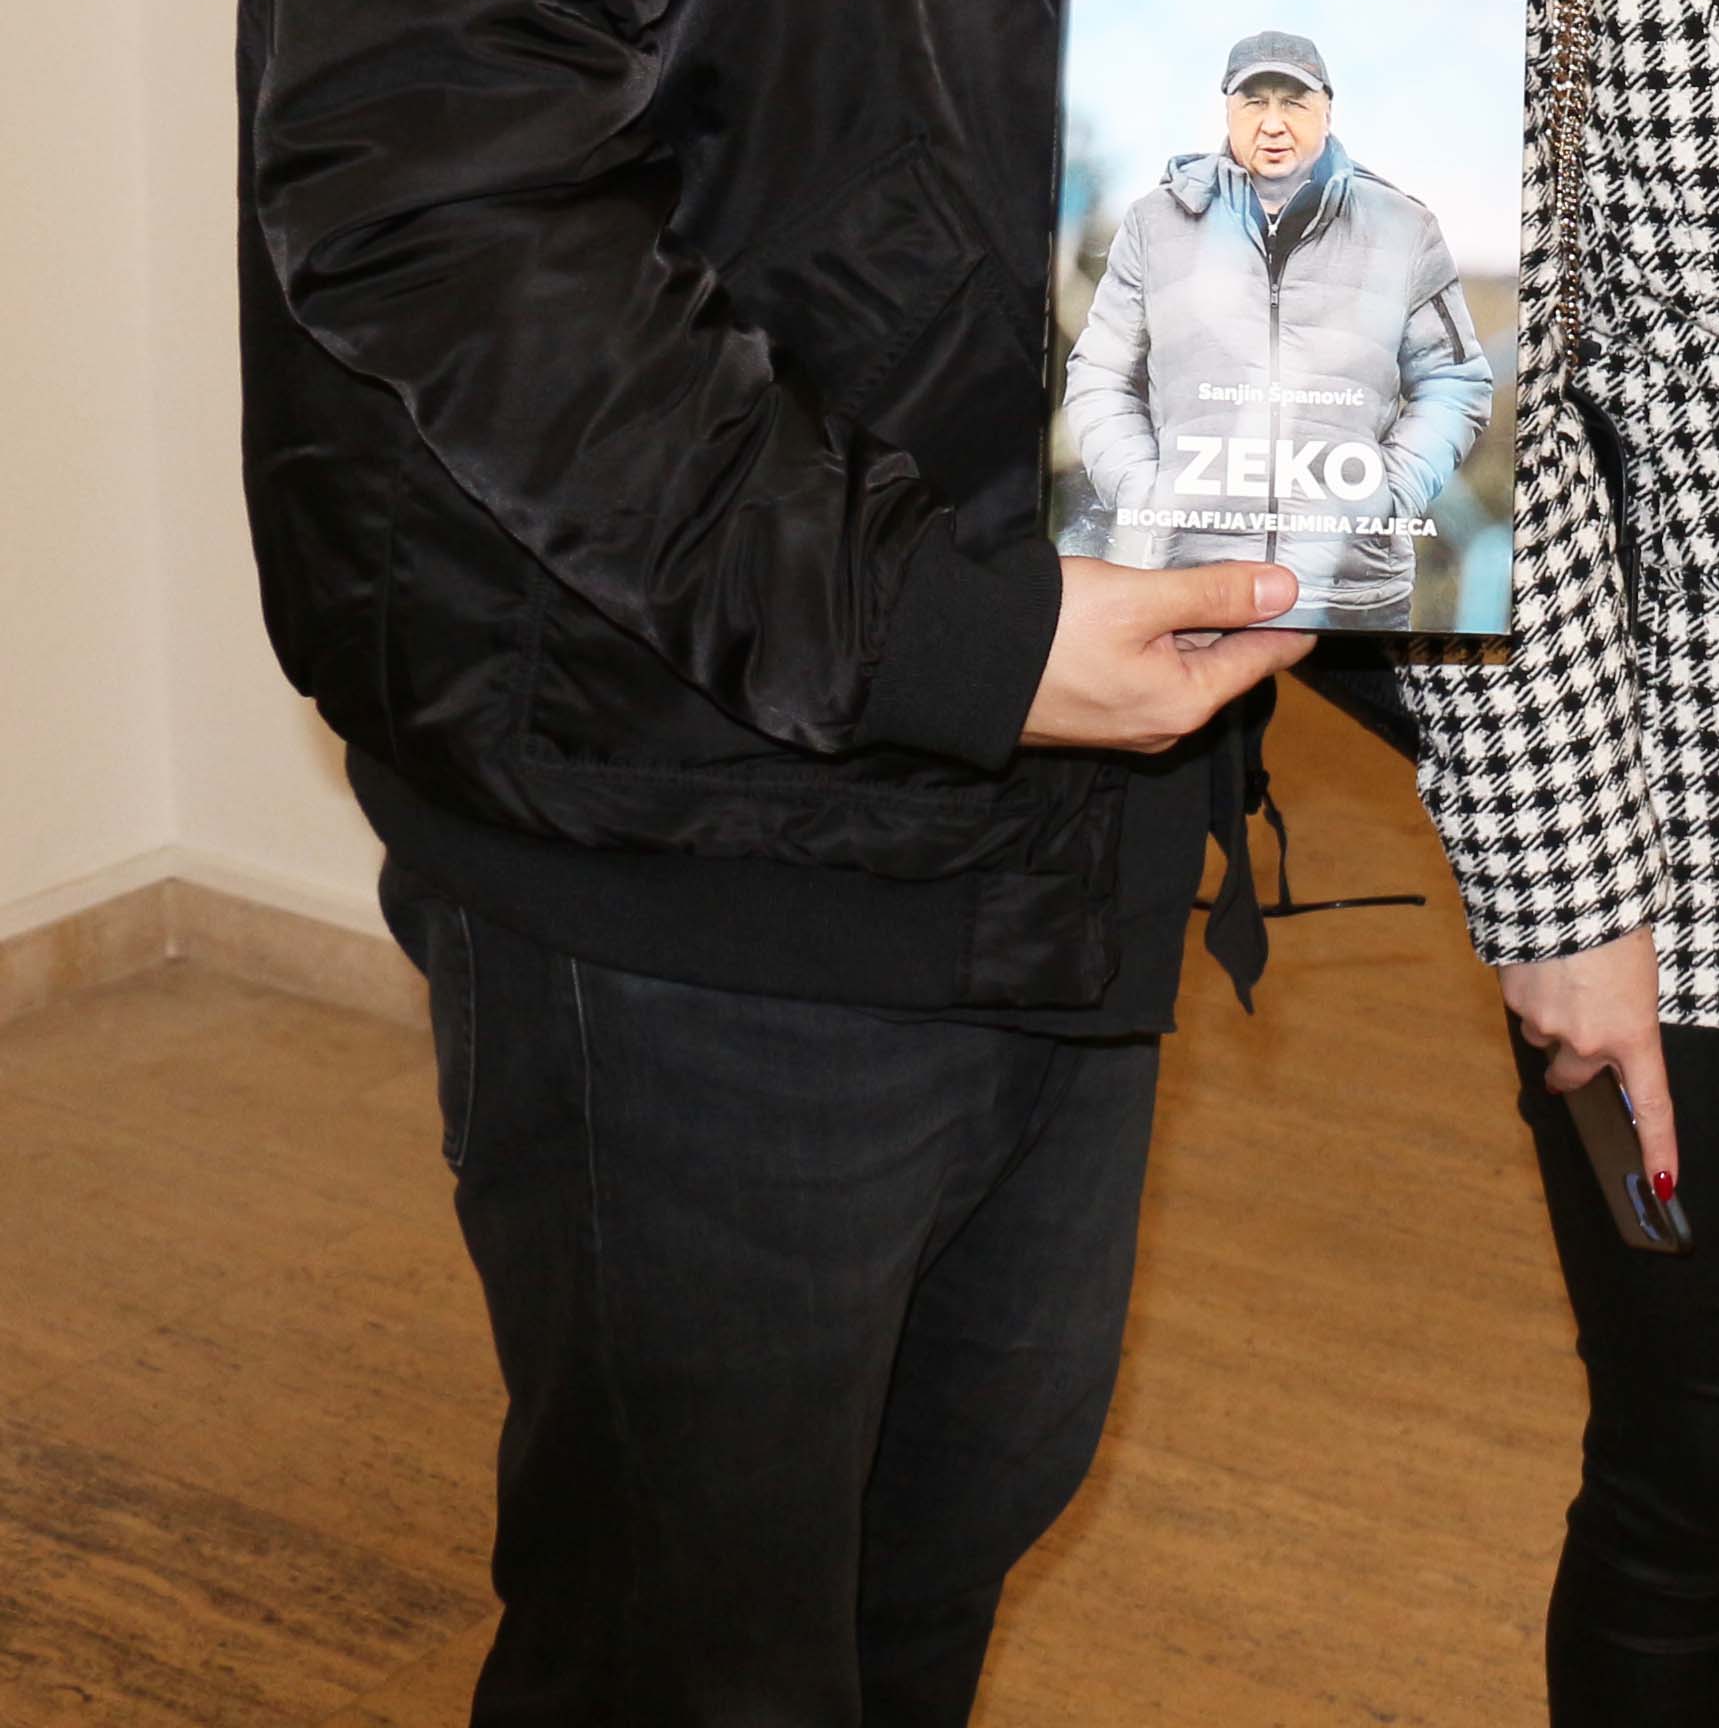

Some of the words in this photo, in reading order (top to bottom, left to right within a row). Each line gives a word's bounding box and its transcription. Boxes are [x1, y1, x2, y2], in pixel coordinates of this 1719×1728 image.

[1197, 382, 1263, 406] Sanjin
[1268, 381, 1365, 407] Španović
[1174, 434, 1384, 501] ZEKO
[1116, 507, 1247, 530] BIOGRAFIJA
[1248, 512, 1353, 534] VELIMIRA
[1354, 515, 1438, 537] ZAJECA
